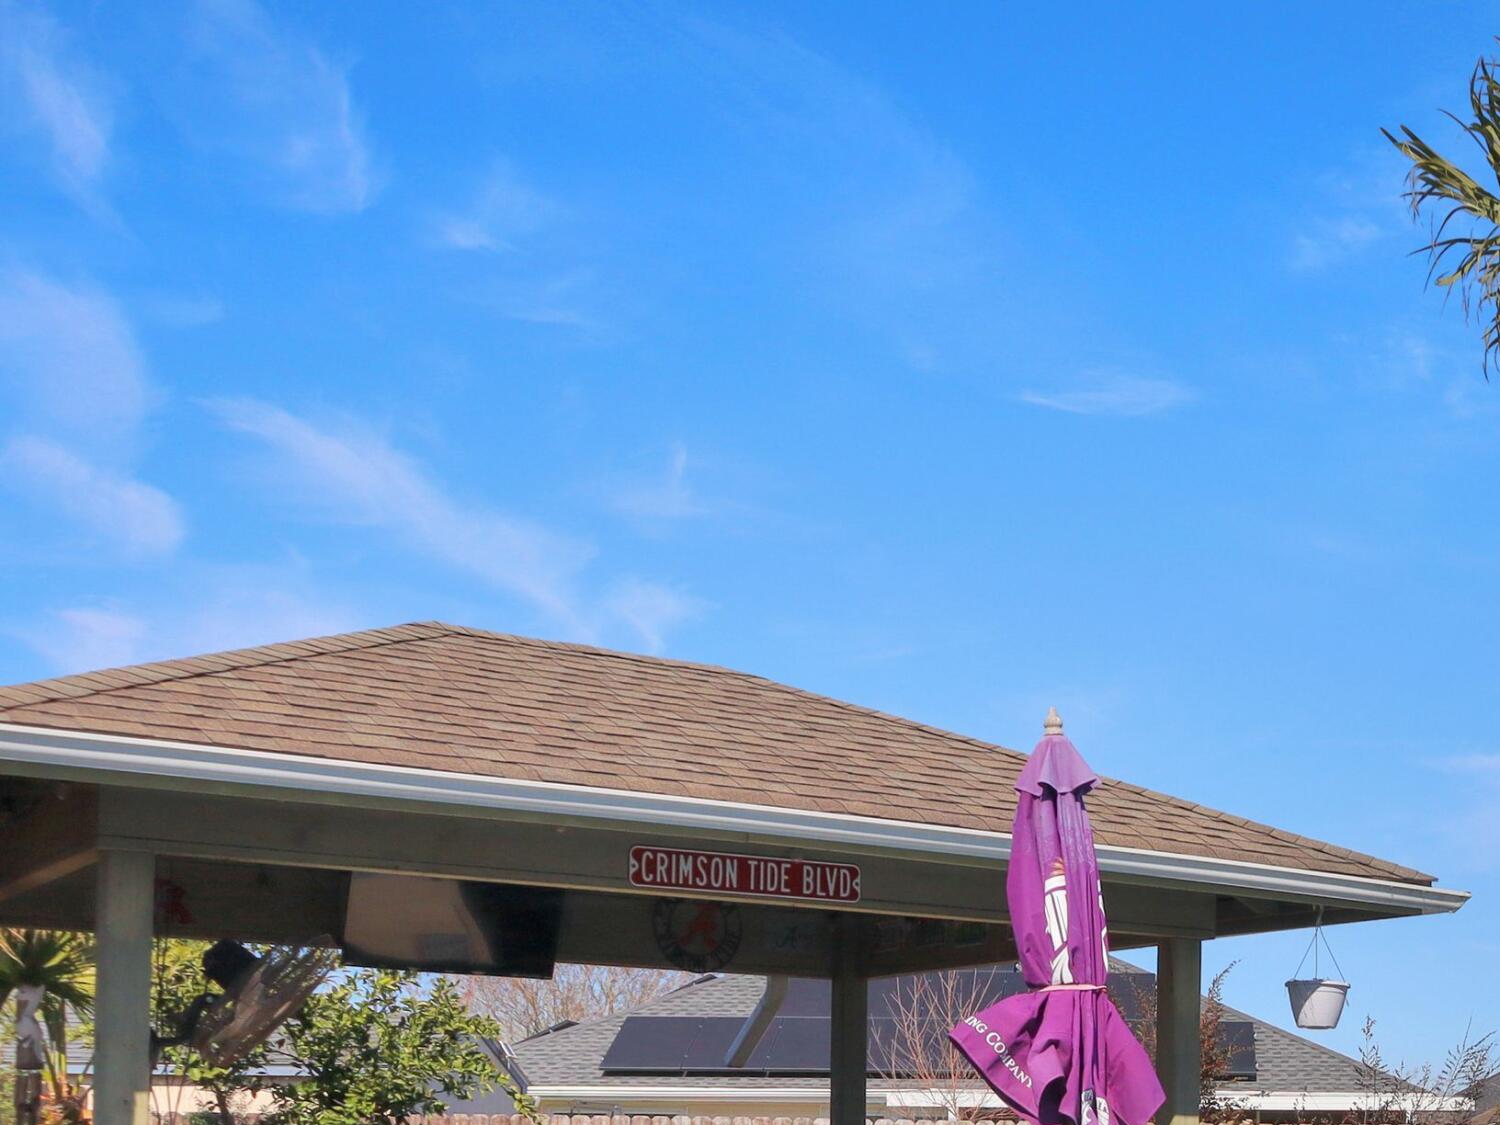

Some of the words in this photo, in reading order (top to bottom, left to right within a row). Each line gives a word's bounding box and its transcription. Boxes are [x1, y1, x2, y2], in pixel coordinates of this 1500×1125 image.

[641, 851, 738, 888] CRIMSON
[747, 860, 792, 893] TIDE
[802, 865, 851, 898] BLVD
